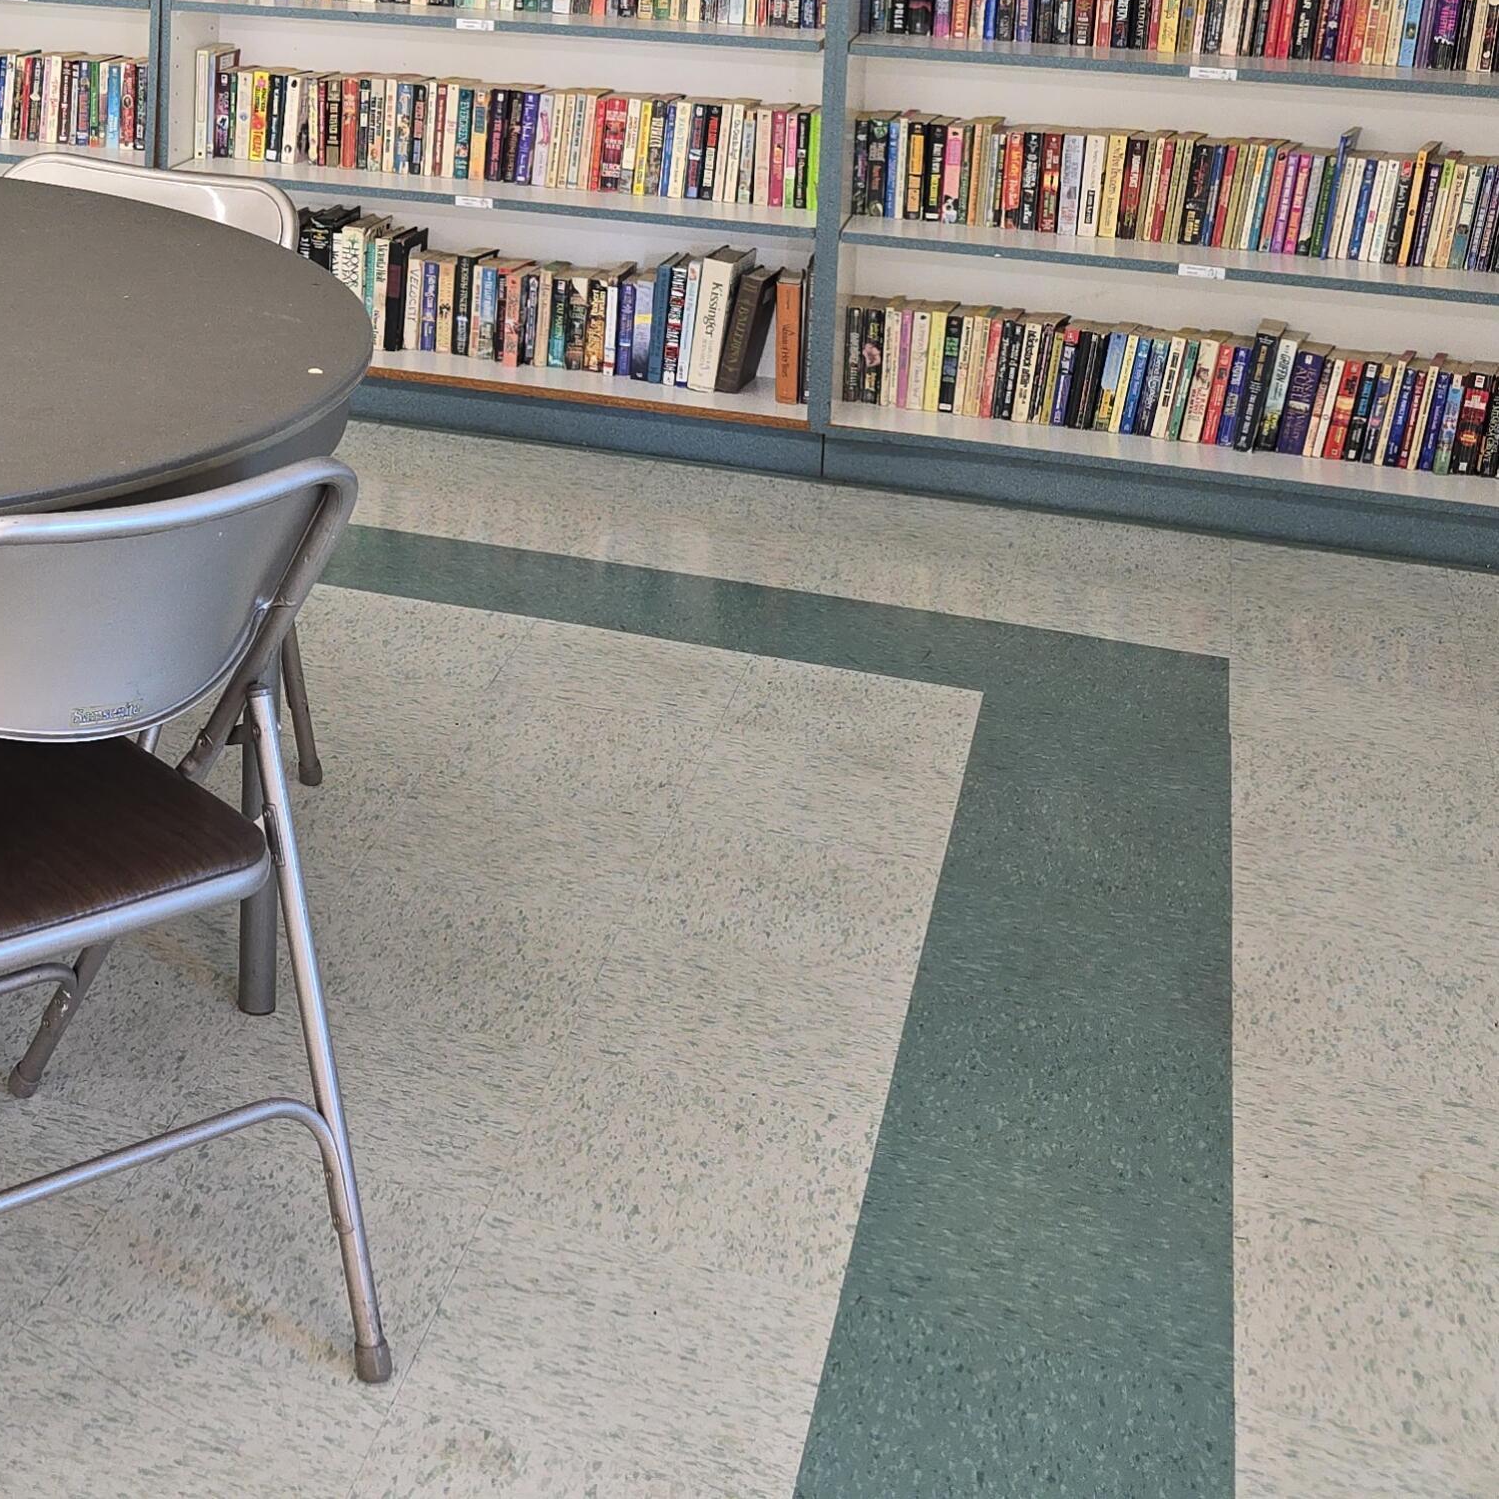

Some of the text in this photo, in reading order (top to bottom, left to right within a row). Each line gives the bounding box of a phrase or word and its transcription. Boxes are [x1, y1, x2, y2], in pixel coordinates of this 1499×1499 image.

[893, 3, 904, 28] PULSE
[458, 101, 469, 142] EVERGREEN
[252, 131, 263, 157] THERAPY
[348, 248, 358, 287] HONOR
[407, 269, 419, 322] VELOCITY
[700, 281, 724, 337] Kissinger
[1275, 353, 1291, 382] GRIFFIN
[1291, 365, 1309, 400] AUEL
